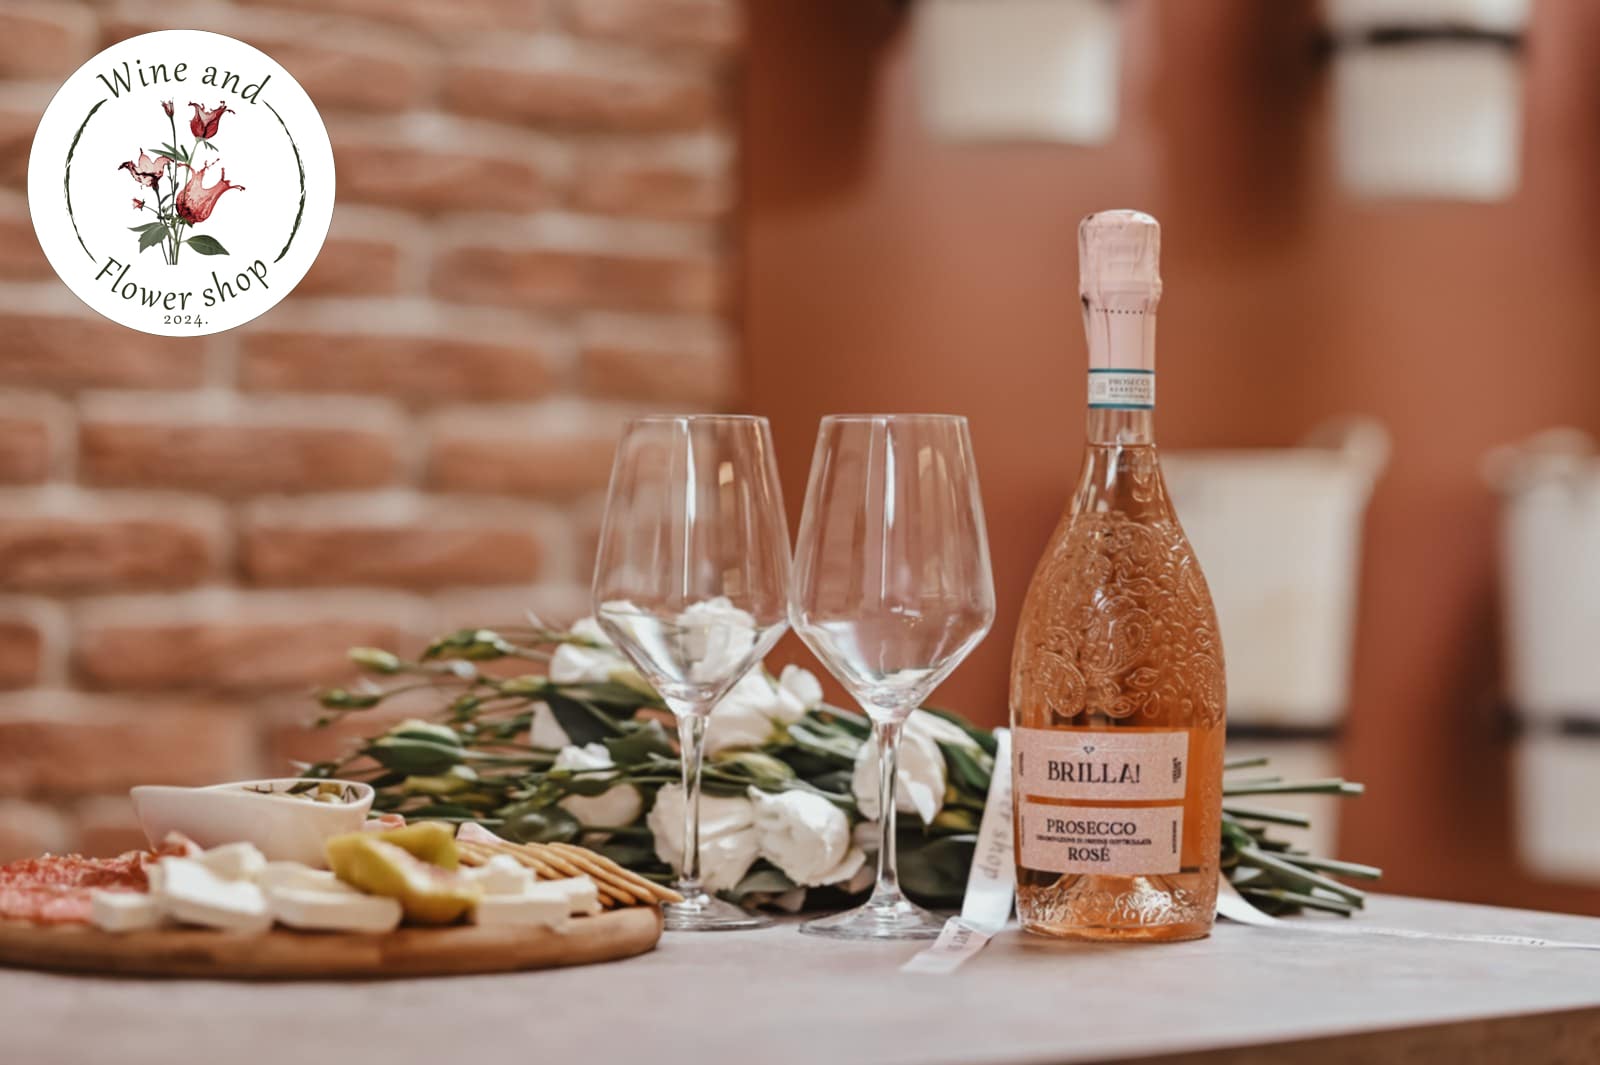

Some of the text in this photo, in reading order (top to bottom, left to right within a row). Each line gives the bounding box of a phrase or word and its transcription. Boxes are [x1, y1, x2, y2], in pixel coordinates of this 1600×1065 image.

[1047, 760, 1140, 783] BRILLA!
[1046, 819, 1137, 836] PROSECCO
[1068, 846, 1110, 862] ROSÉ
